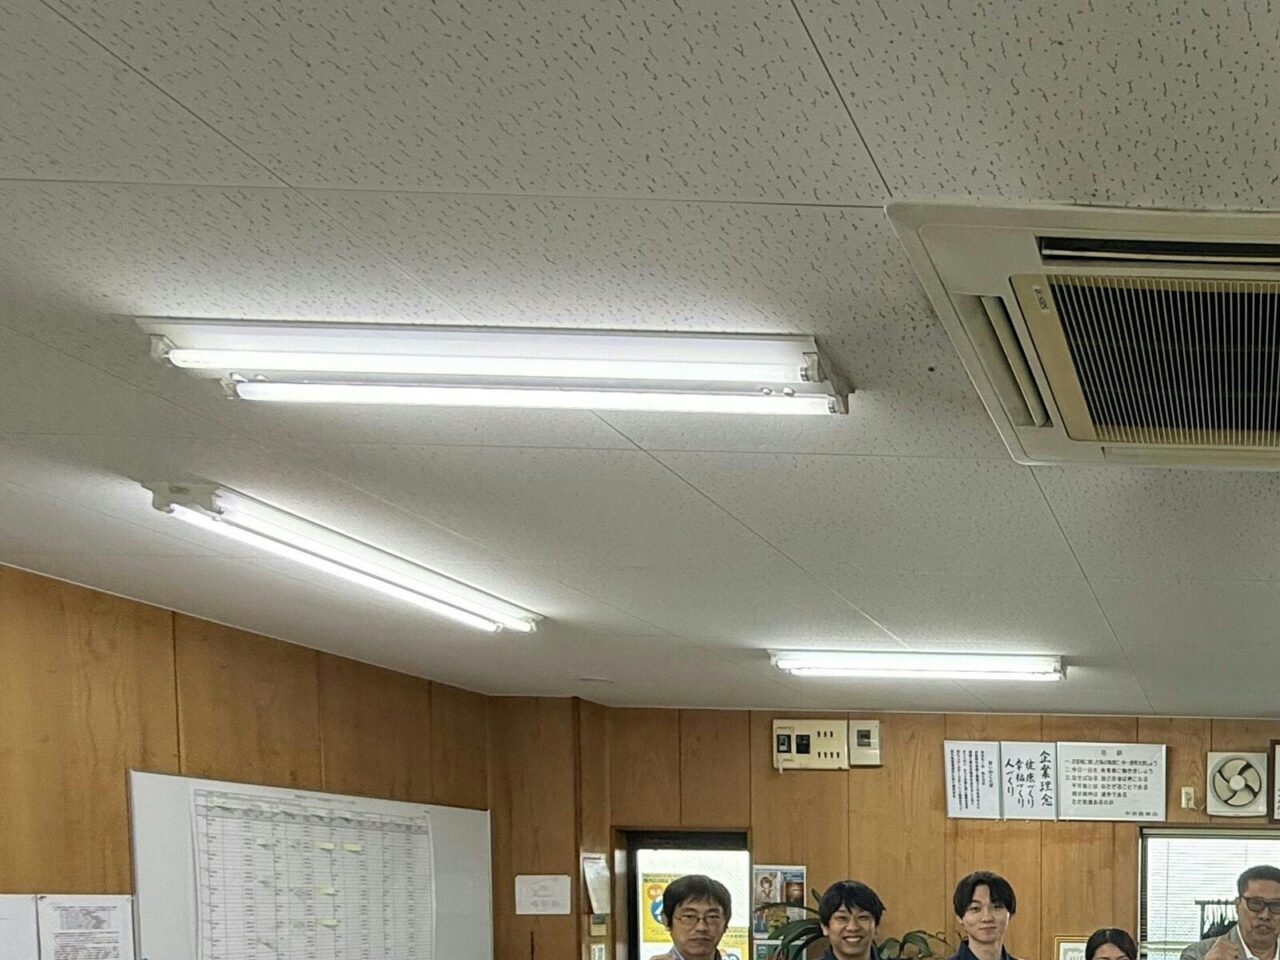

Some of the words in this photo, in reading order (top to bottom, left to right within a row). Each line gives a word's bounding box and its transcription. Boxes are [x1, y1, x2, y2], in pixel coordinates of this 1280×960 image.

[1005, 758, 1015, 797] 人づくり
[1039, 750, 1053, 807] 企業理念
